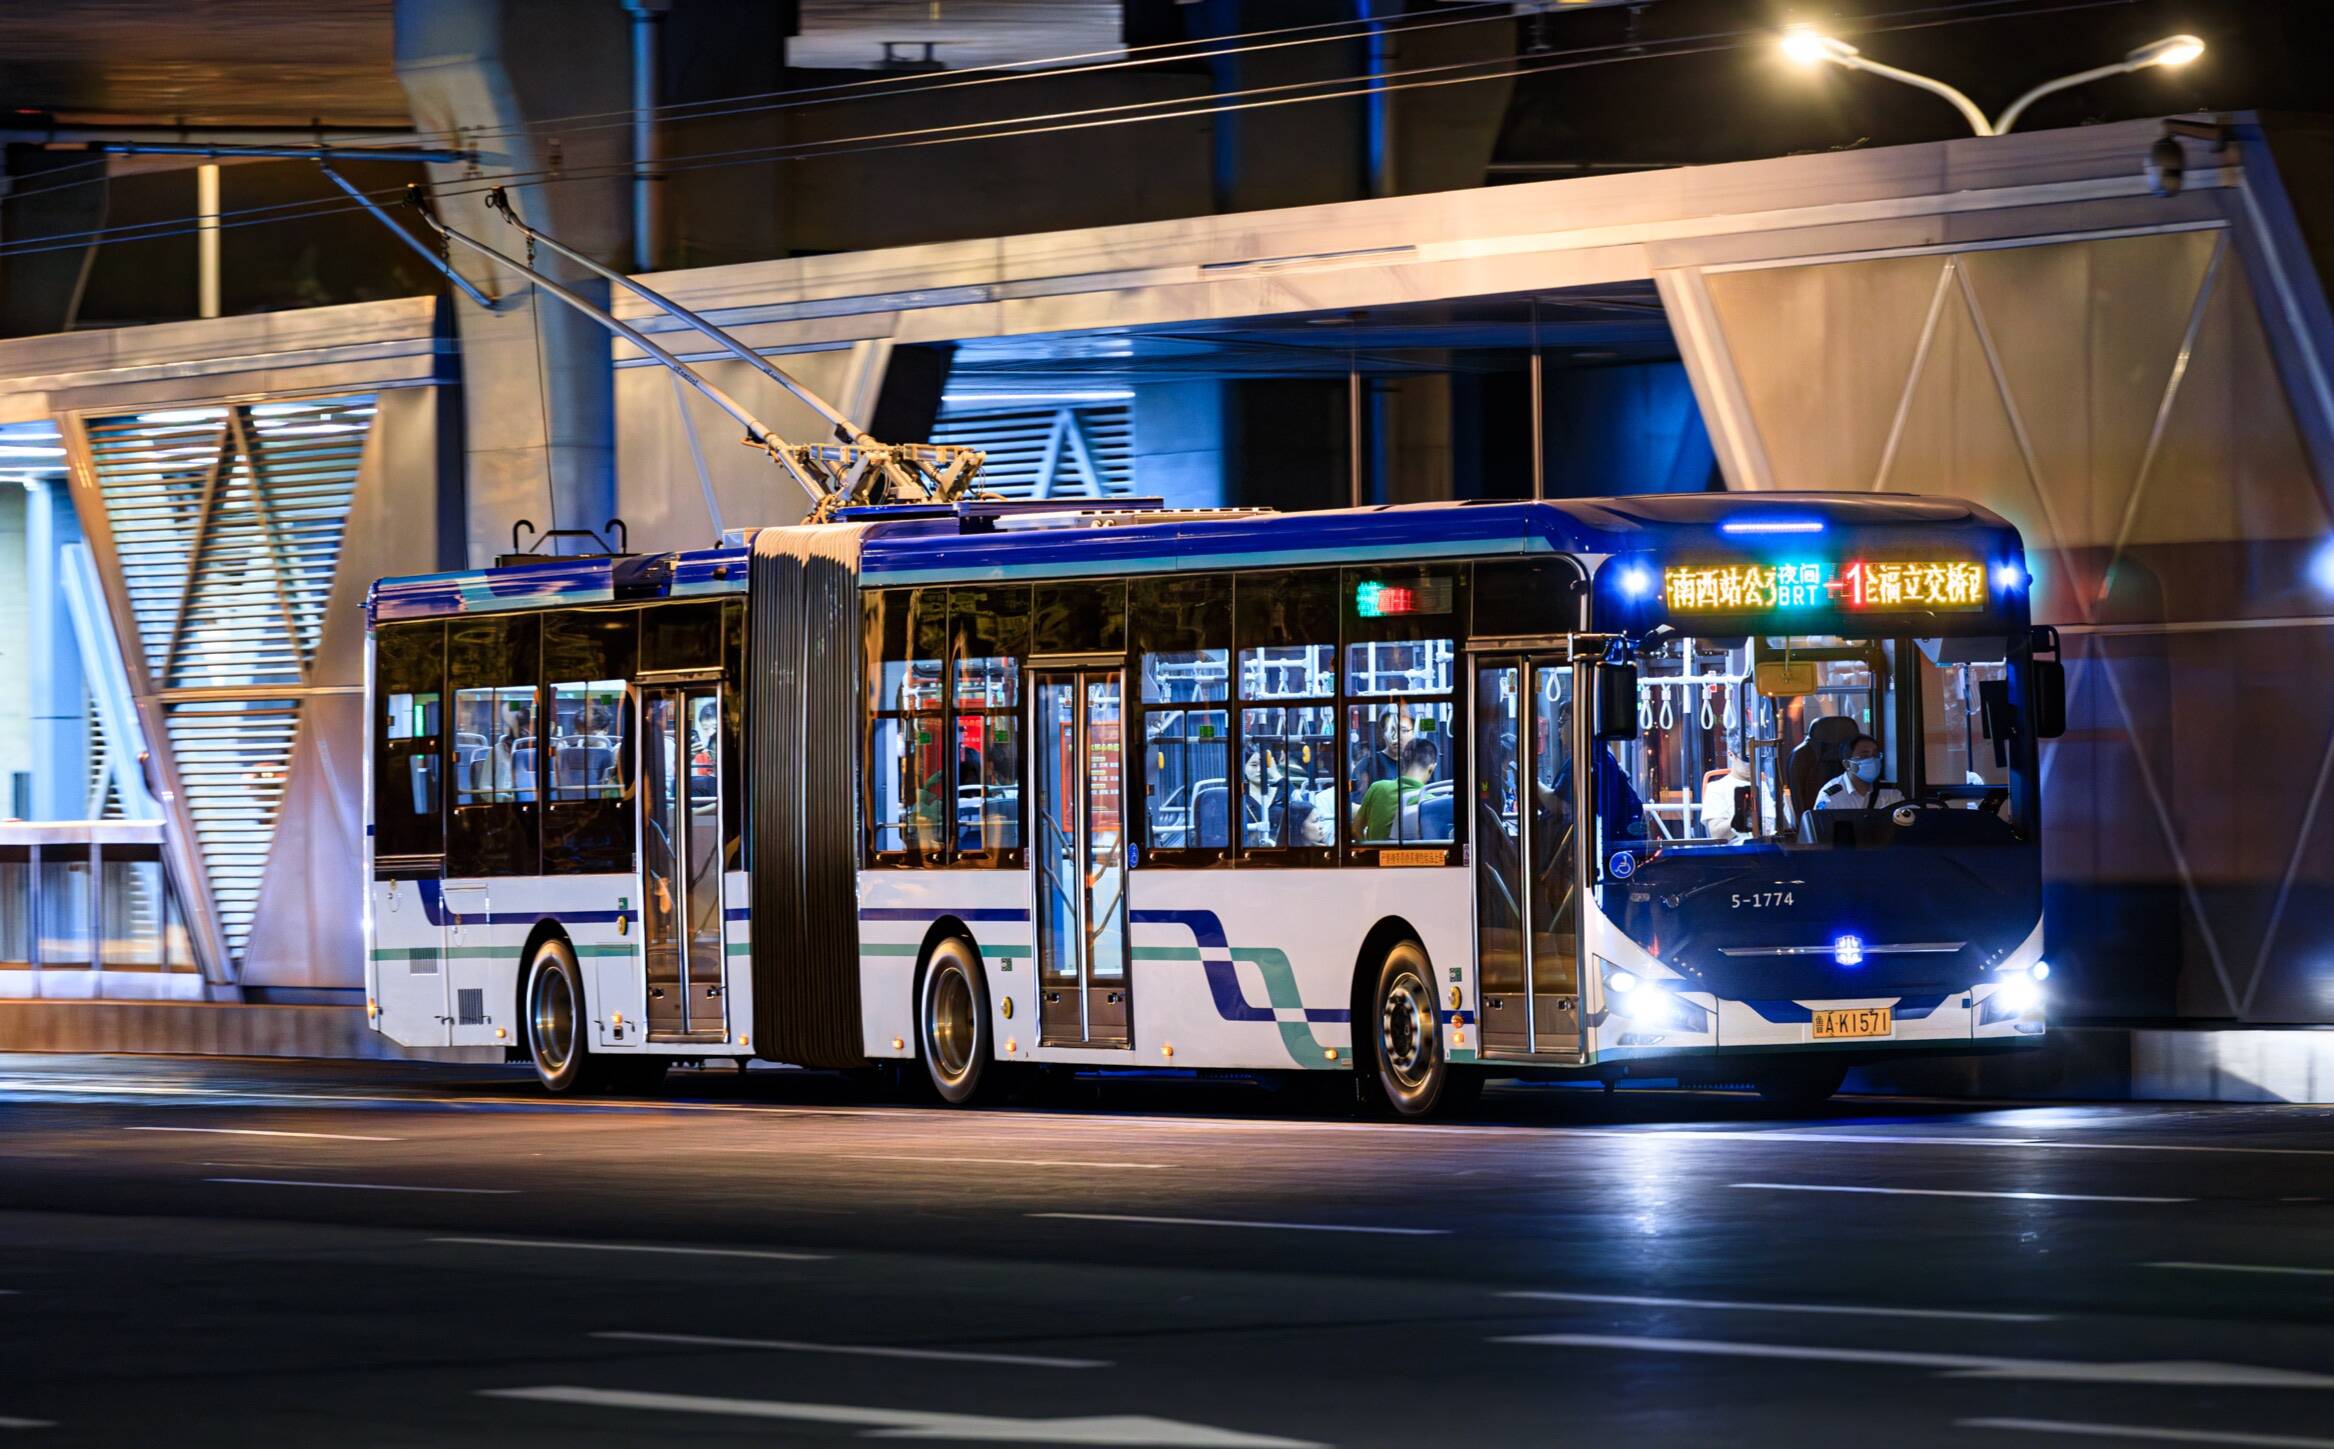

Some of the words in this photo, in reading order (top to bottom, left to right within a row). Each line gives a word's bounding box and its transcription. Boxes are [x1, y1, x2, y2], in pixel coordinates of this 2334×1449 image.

[1777, 563, 1820, 585] 夜间
[1665, 566, 1776, 608] 南西站公
[1731, 892, 1794, 908] 5-1774
